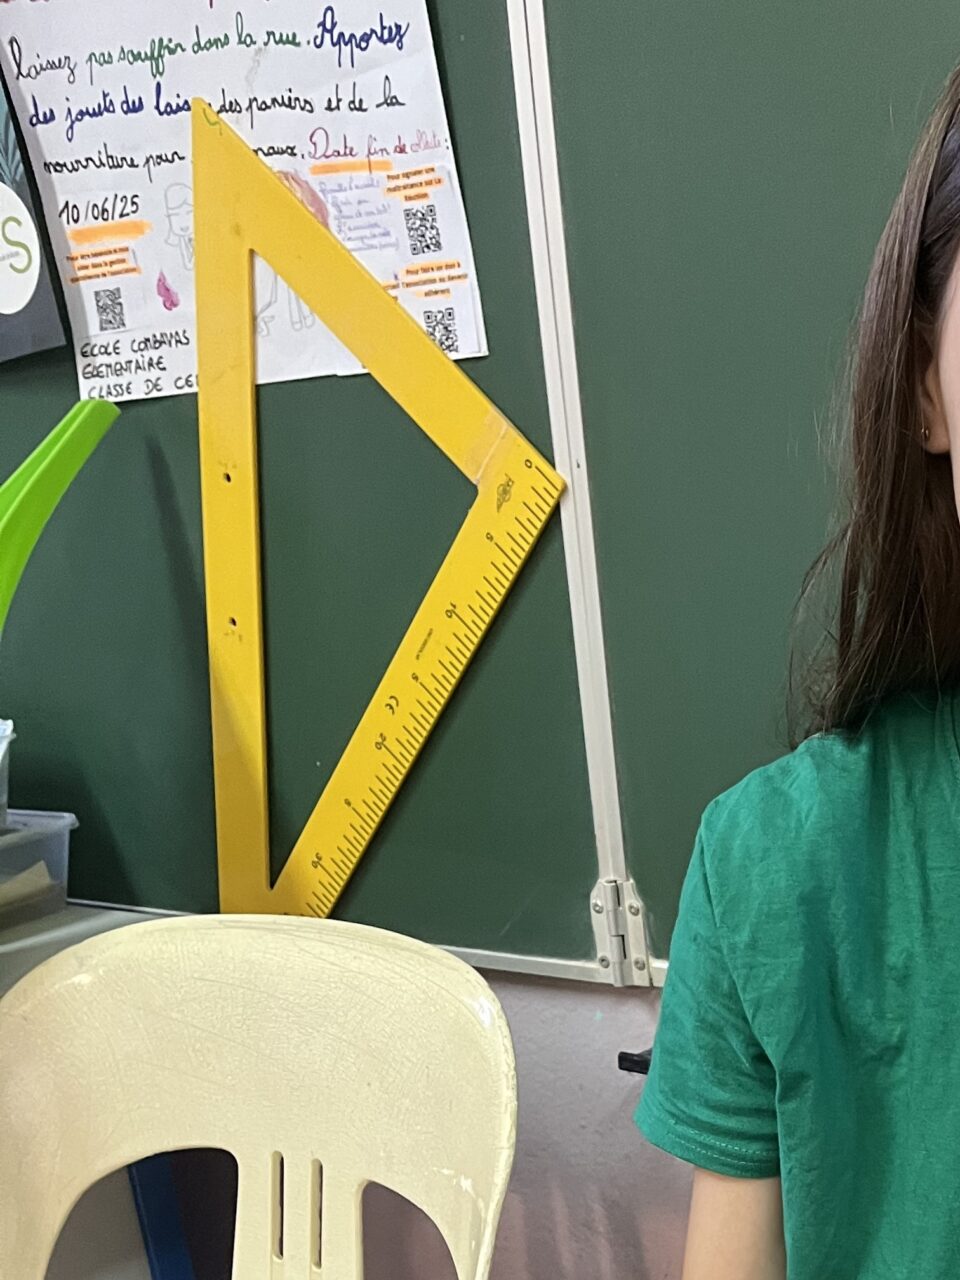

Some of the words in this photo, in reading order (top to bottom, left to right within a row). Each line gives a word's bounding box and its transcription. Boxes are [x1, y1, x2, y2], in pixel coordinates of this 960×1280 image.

[86, 51, 113, 85] pas
[192, 25, 230, 54] dans
[236, 11, 257, 45] la
[29, 94, 56, 127] des
[120, 85, 144, 115] des
[216, 88, 242, 114] des
[324, 83, 341, 112] et
[348, 81, 368, 112] de
[376, 75, 406, 107] la
[143, 151, 185, 183] pour
[308, 127, 358, 160] Date
[366, 134, 390, 174] fin
[393, 135, 408, 154] de
[58, 193, 140, 225] 10/06/25
[81, 339, 121, 358] ECOLE
[87, 381, 133, 400] CLASSE
[143, 377, 163, 397] DE
